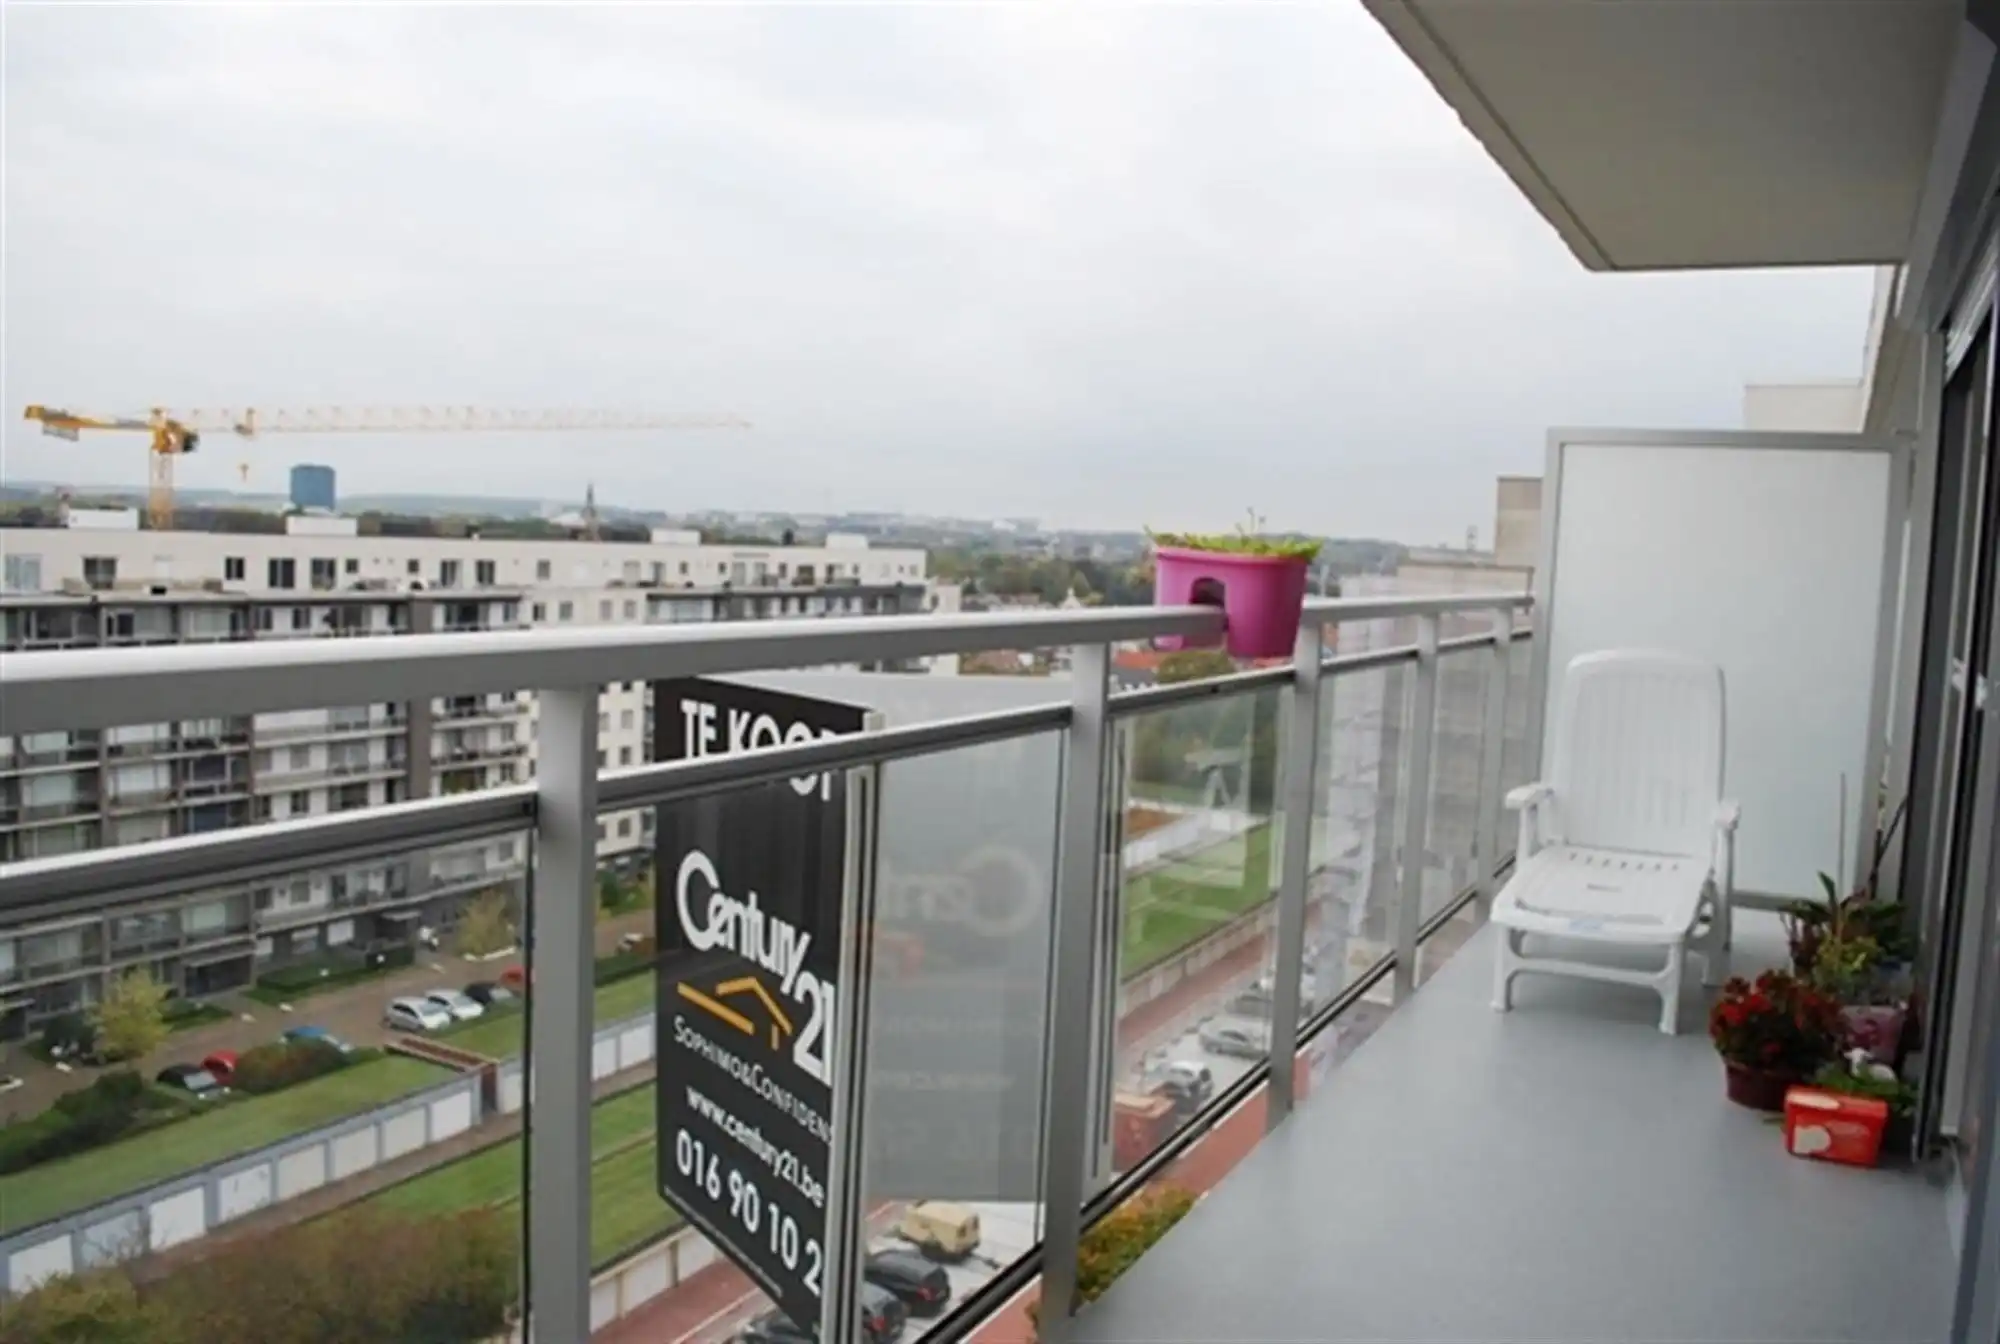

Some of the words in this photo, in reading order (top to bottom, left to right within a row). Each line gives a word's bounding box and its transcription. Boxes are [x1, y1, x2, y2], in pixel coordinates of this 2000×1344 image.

[680, 699, 717, 759] TE
[676, 850, 812, 995] Century
[793, 971, 836, 1087] 21
[675, 1128, 721, 1200] 016
[727, 1167, 761, 1234] 90
[767, 1202, 800, 1271] 10
[802, 1237, 823, 1297] 2
[685, 1085, 825, 1208] www.century21.be
